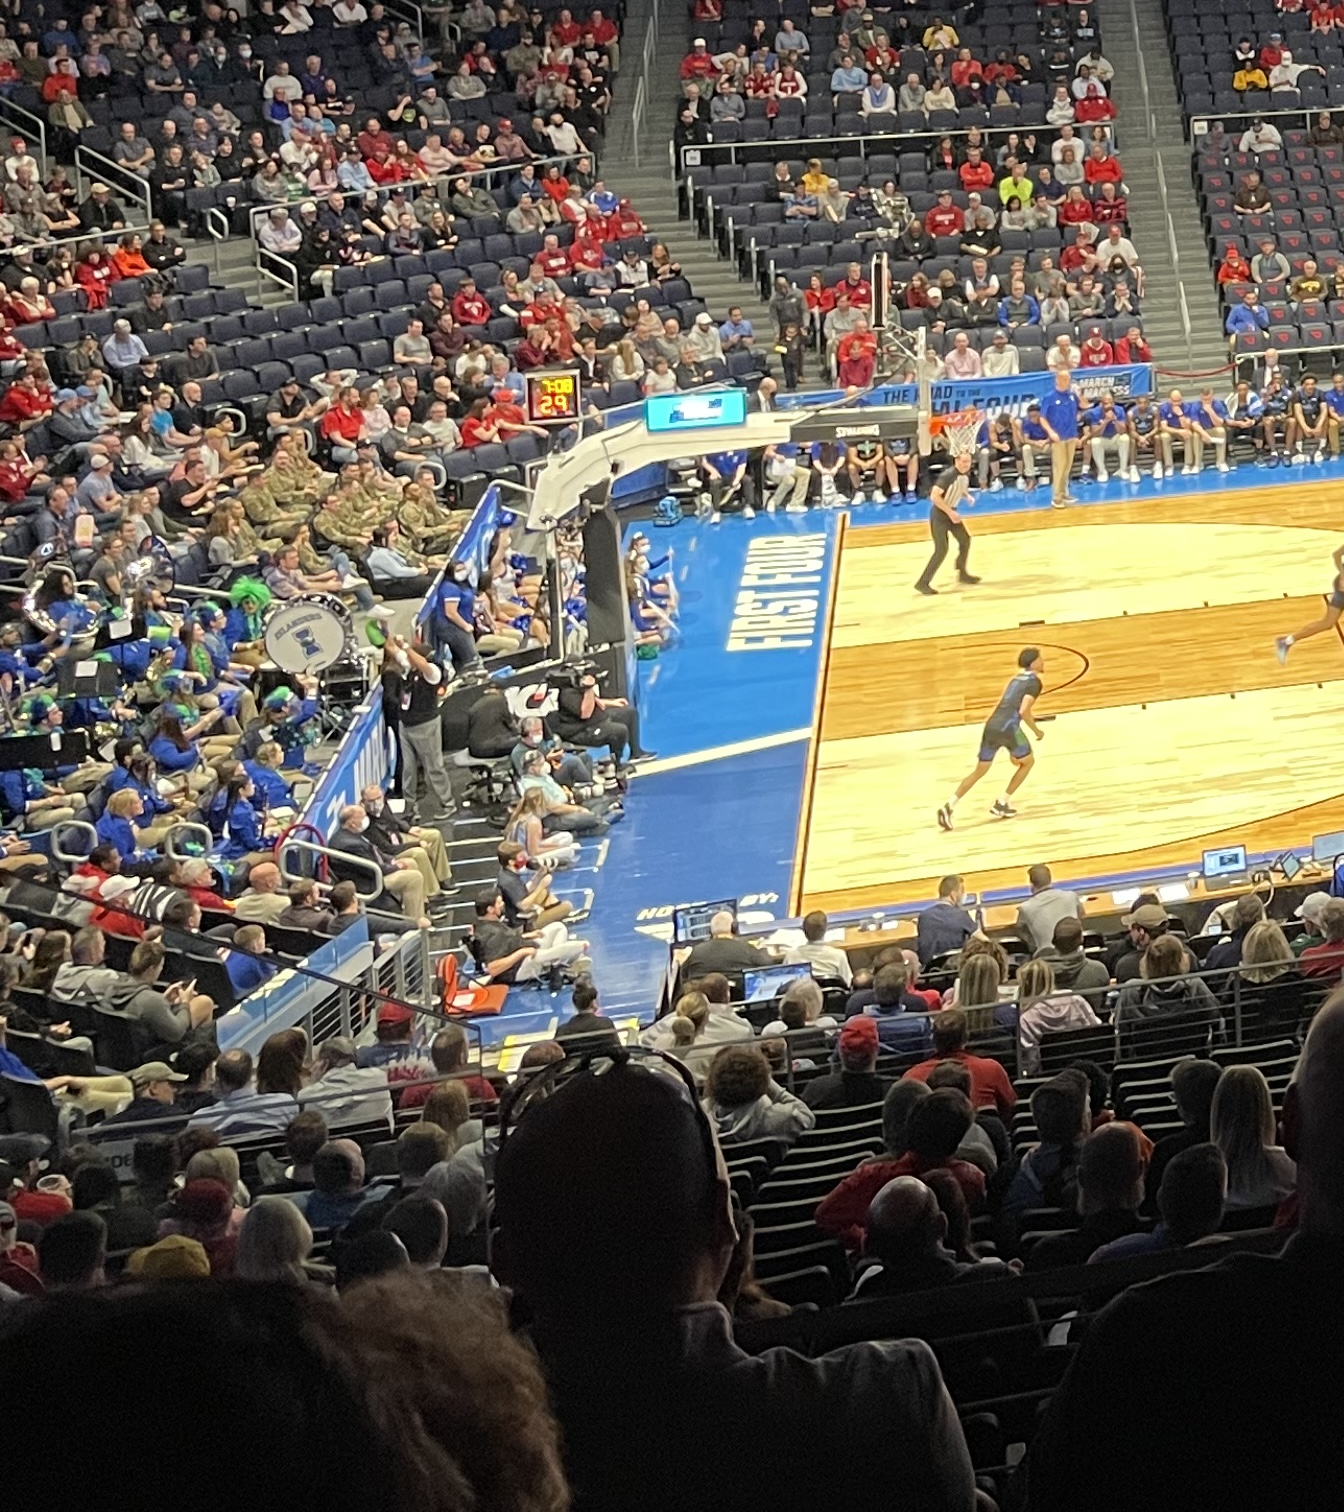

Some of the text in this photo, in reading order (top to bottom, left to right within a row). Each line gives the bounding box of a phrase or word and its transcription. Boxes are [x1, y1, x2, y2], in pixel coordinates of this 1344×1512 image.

[541, 378, 573, 393] 7:08
[1079, 377, 1115, 388] MARCH
[540, 395, 567, 414] 29
[884, 389, 909, 404] THE
[741, 533, 828, 587] FOUR
[726, 589, 820, 652] FIRST
